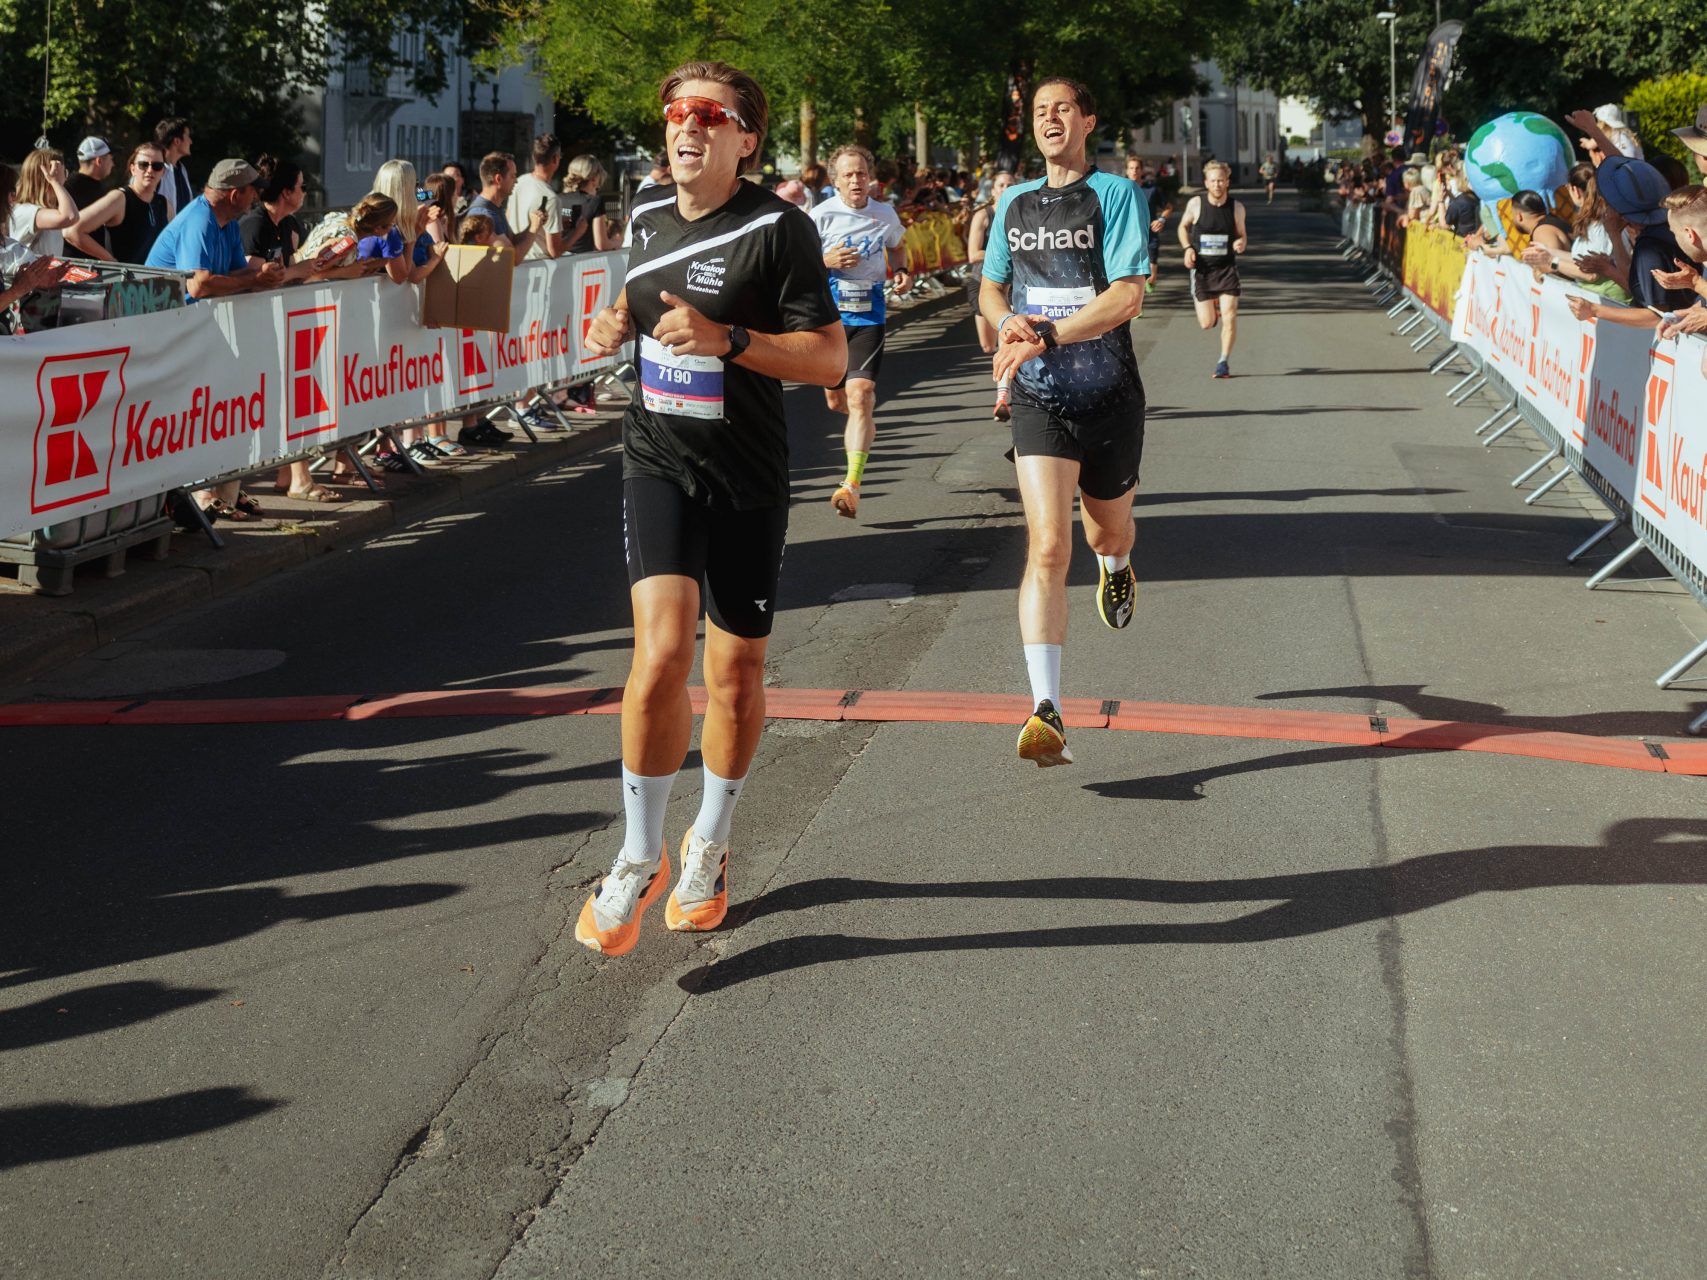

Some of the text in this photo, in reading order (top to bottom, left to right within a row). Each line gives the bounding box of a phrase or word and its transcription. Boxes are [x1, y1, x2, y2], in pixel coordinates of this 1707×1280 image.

[691, 261, 726, 276] Kruskop
[1008, 224, 1095, 252] Schad
[695, 275, 724, 287] Mühle
[344, 337, 444, 406] Kaufland
[496, 315, 570, 370] Kaufland
[1541, 336, 1573, 407] Kaufland
[658, 365, 692, 385] 7190
[121, 373, 266, 467] Kaufland
[1591, 378, 1637, 466] Kaufland
[1671, 432, 1707, 531] Kauf
